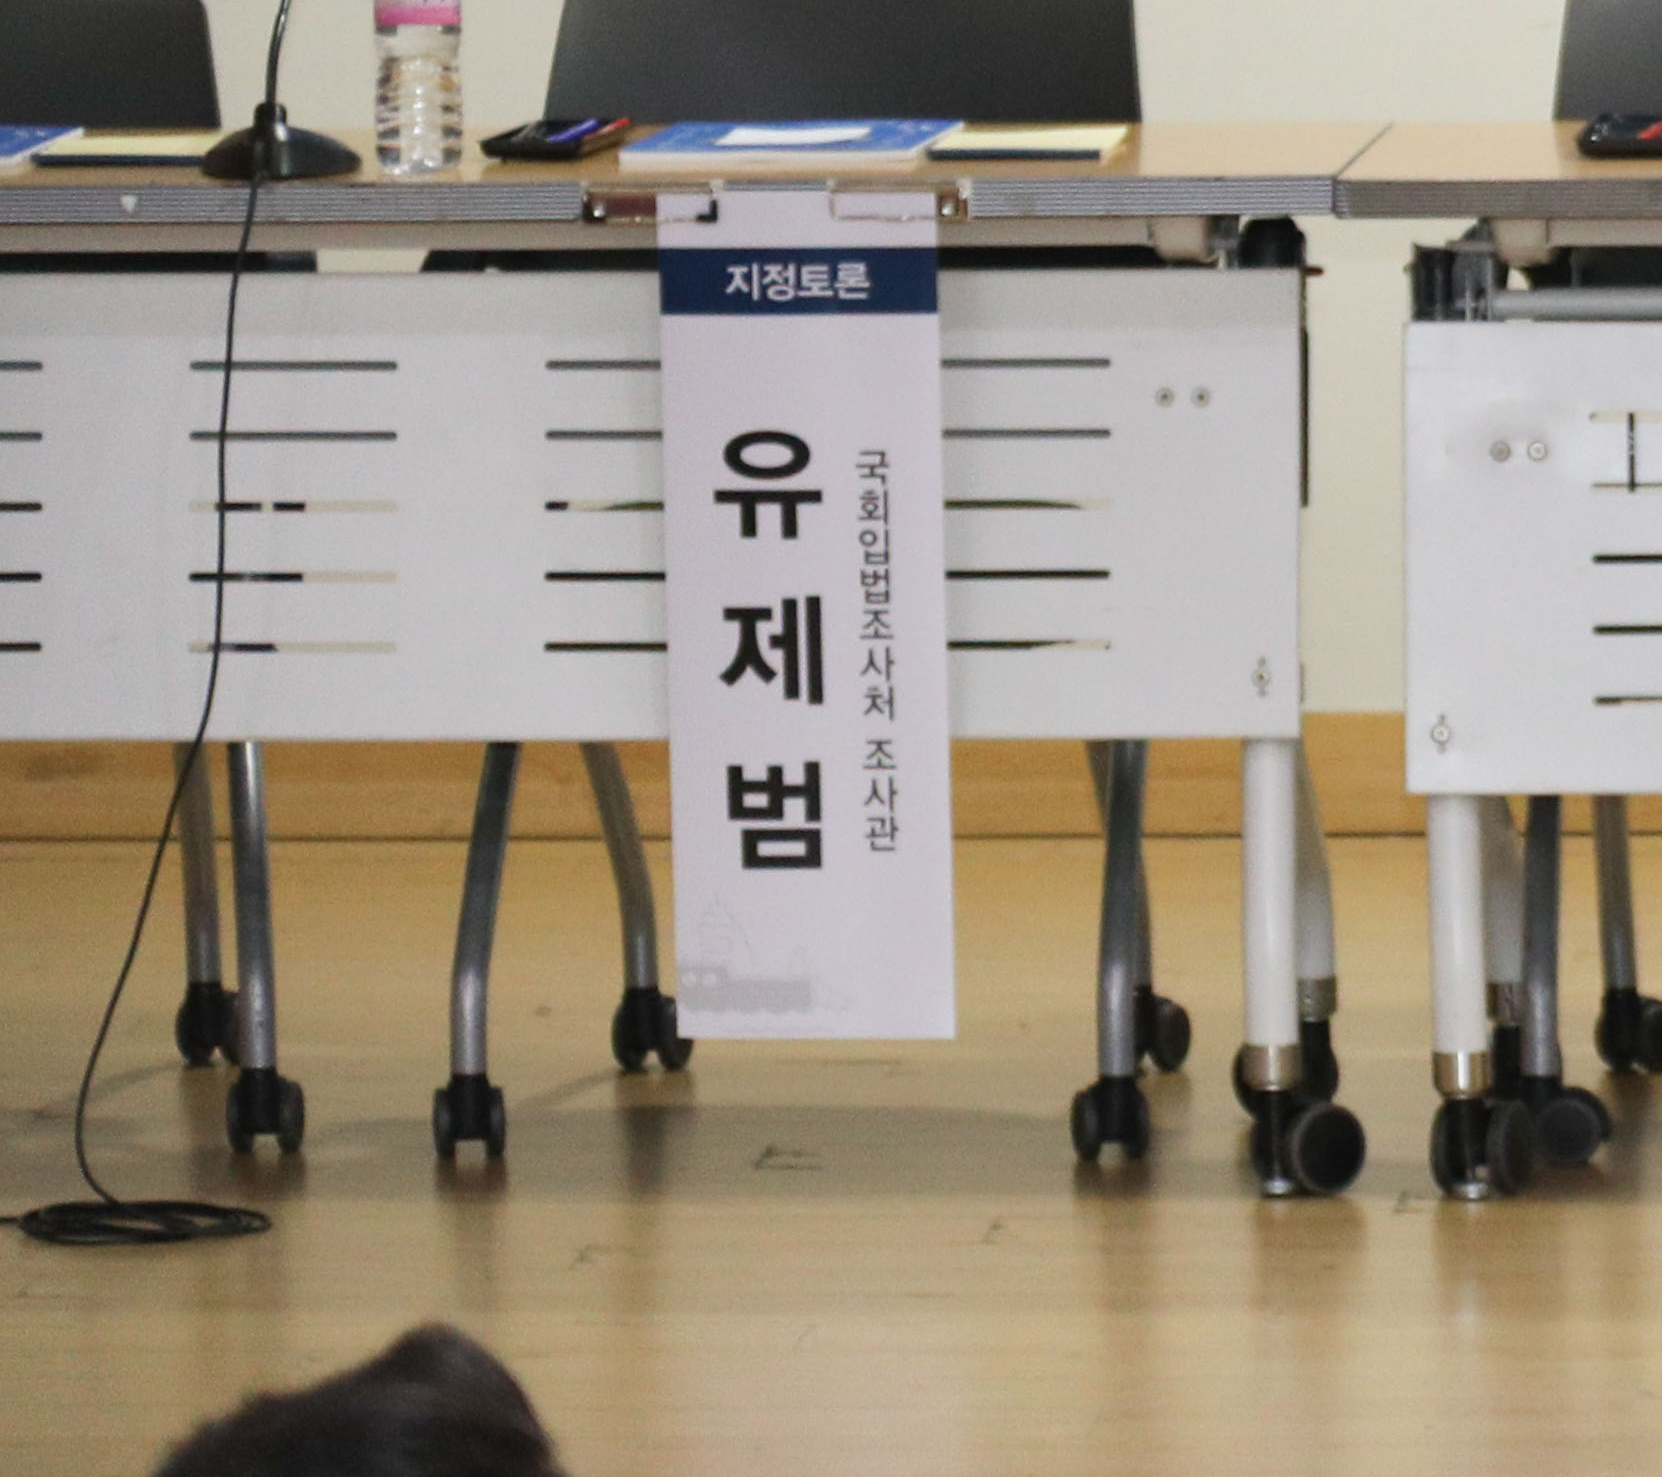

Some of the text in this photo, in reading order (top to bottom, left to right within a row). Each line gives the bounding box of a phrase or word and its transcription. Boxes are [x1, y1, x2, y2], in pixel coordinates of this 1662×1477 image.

[725, 260, 872, 303] 지정토론
[713, 429, 824, 870] 유제범
[855, 449, 900, 854] 국회입법조사처 조사관
